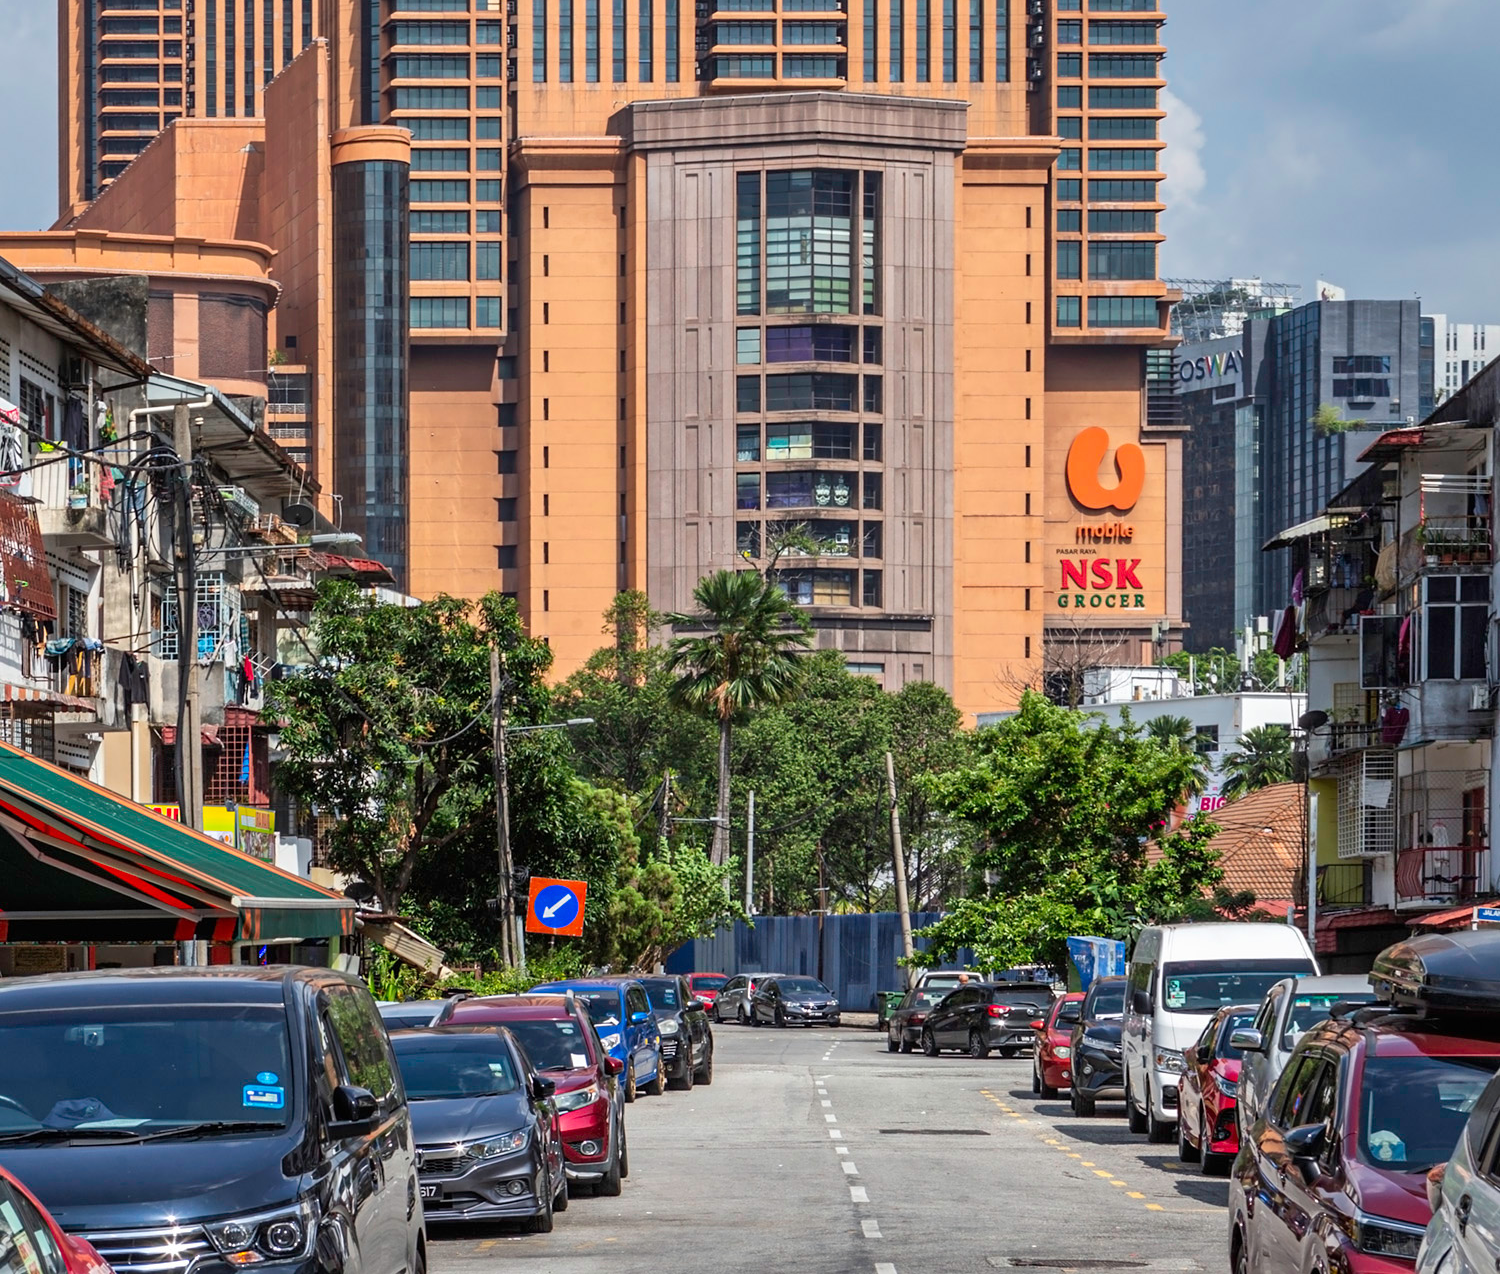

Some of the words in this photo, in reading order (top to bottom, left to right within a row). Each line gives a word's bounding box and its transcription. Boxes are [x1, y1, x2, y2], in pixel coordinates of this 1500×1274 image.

[1076, 521, 1135, 538] mobile
[1060, 558, 1143, 590] NSK
[1057, 594, 1146, 608] GROCER
